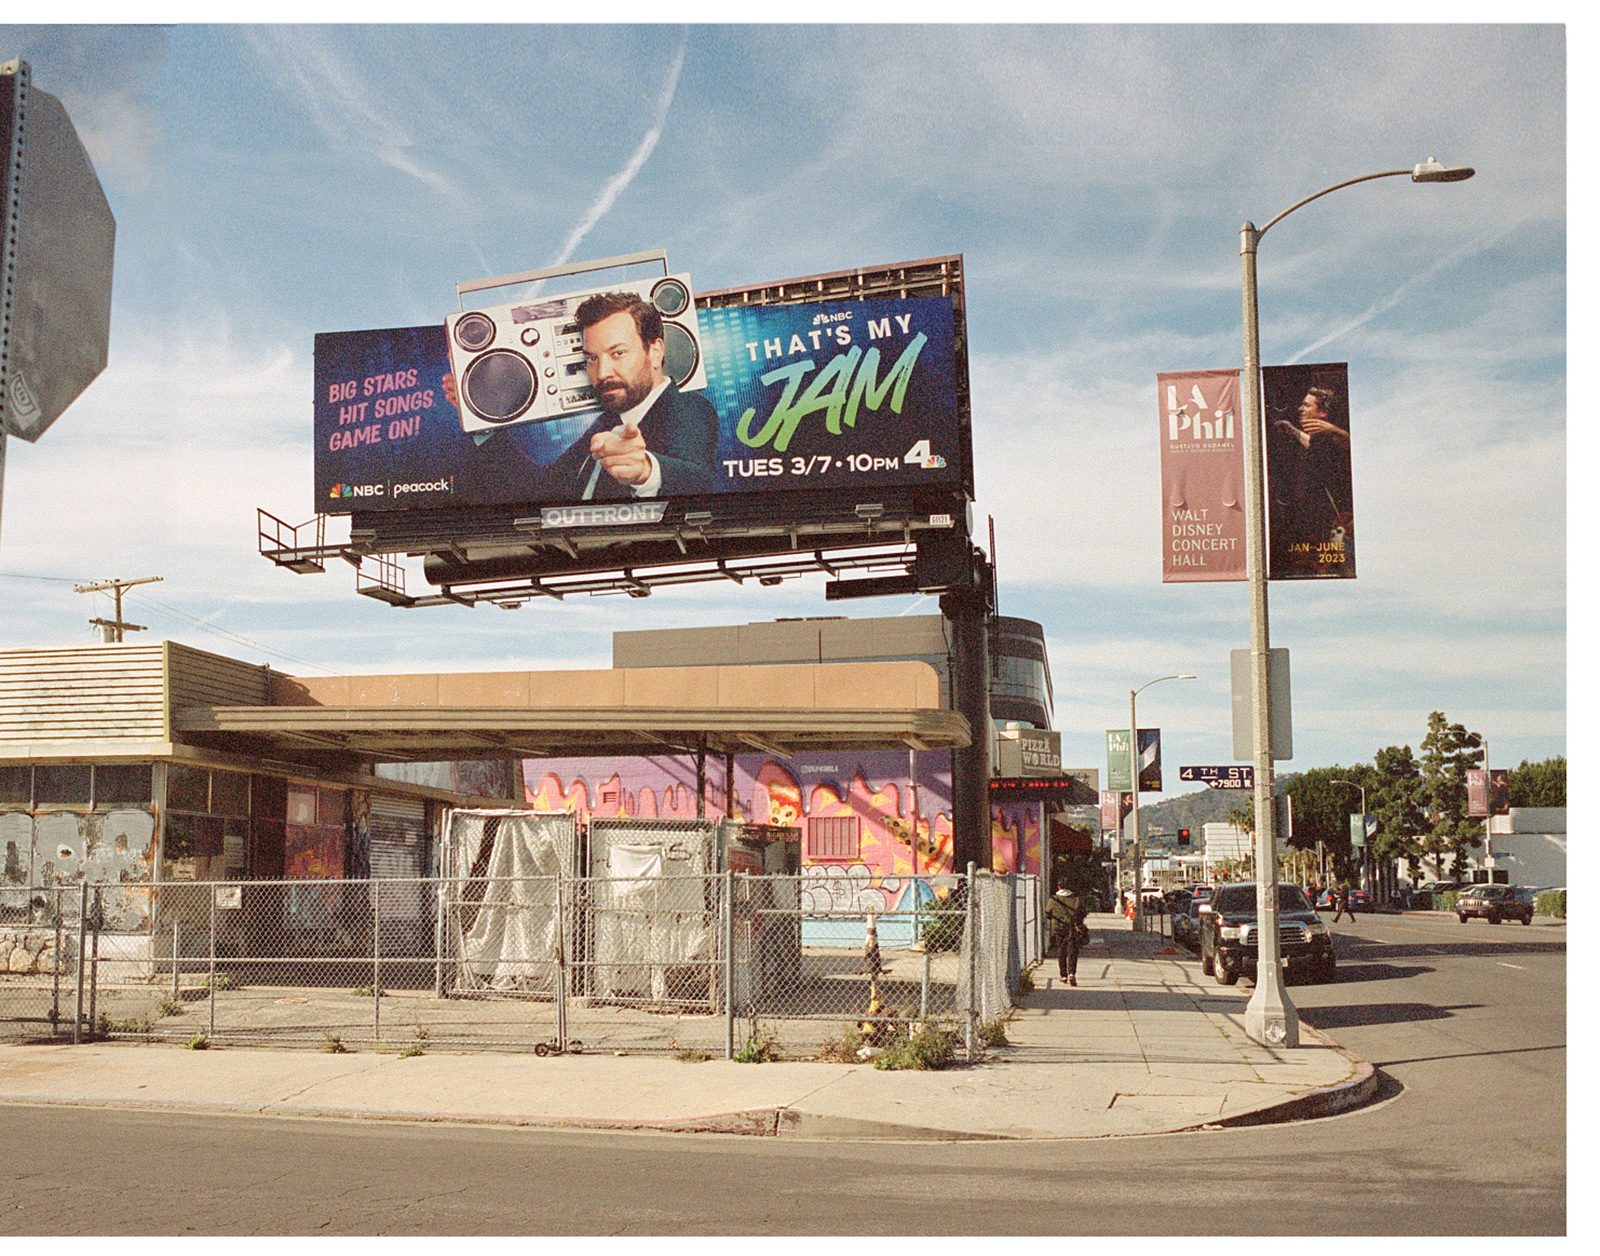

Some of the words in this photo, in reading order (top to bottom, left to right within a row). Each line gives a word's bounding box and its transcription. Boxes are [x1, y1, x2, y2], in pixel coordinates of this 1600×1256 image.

[830, 311, 854, 322] NBC
[746, 326, 852, 361] THAT'S
[867, 314, 912, 340] MY
[329, 381, 357, 403] BIG
[736, 331, 928, 452] JAM
[1167, 384, 1208, 410] LA
[339, 402, 369, 426] HIT
[329, 424, 381, 451] GAME
[388, 415, 421, 440] ON!
[1168, 409, 1234, 440] Phil
[723, 458, 784, 477] TUES
[791, 455, 833, 476] 3/7
[846, 453, 899, 472] 10PM
[904, 440, 932, 469] 4
[353, 485, 384, 497] NBC
[393, 479, 449, 498] peacock
[546, 504, 661, 525] OUTFRONT
[1172, 509, 1208, 521] WALT
[1172, 523, 1223, 537] DISNEY
[1172, 538, 1238, 552] CONCERT
[1172, 554, 1207, 567] HALL
[1318, 553, 1345, 563] 2023
[1021, 736, 1051, 753] PIZZA
[1022, 751, 1060, 767] WORLD
[1218, 779, 1241, 788] 7900
